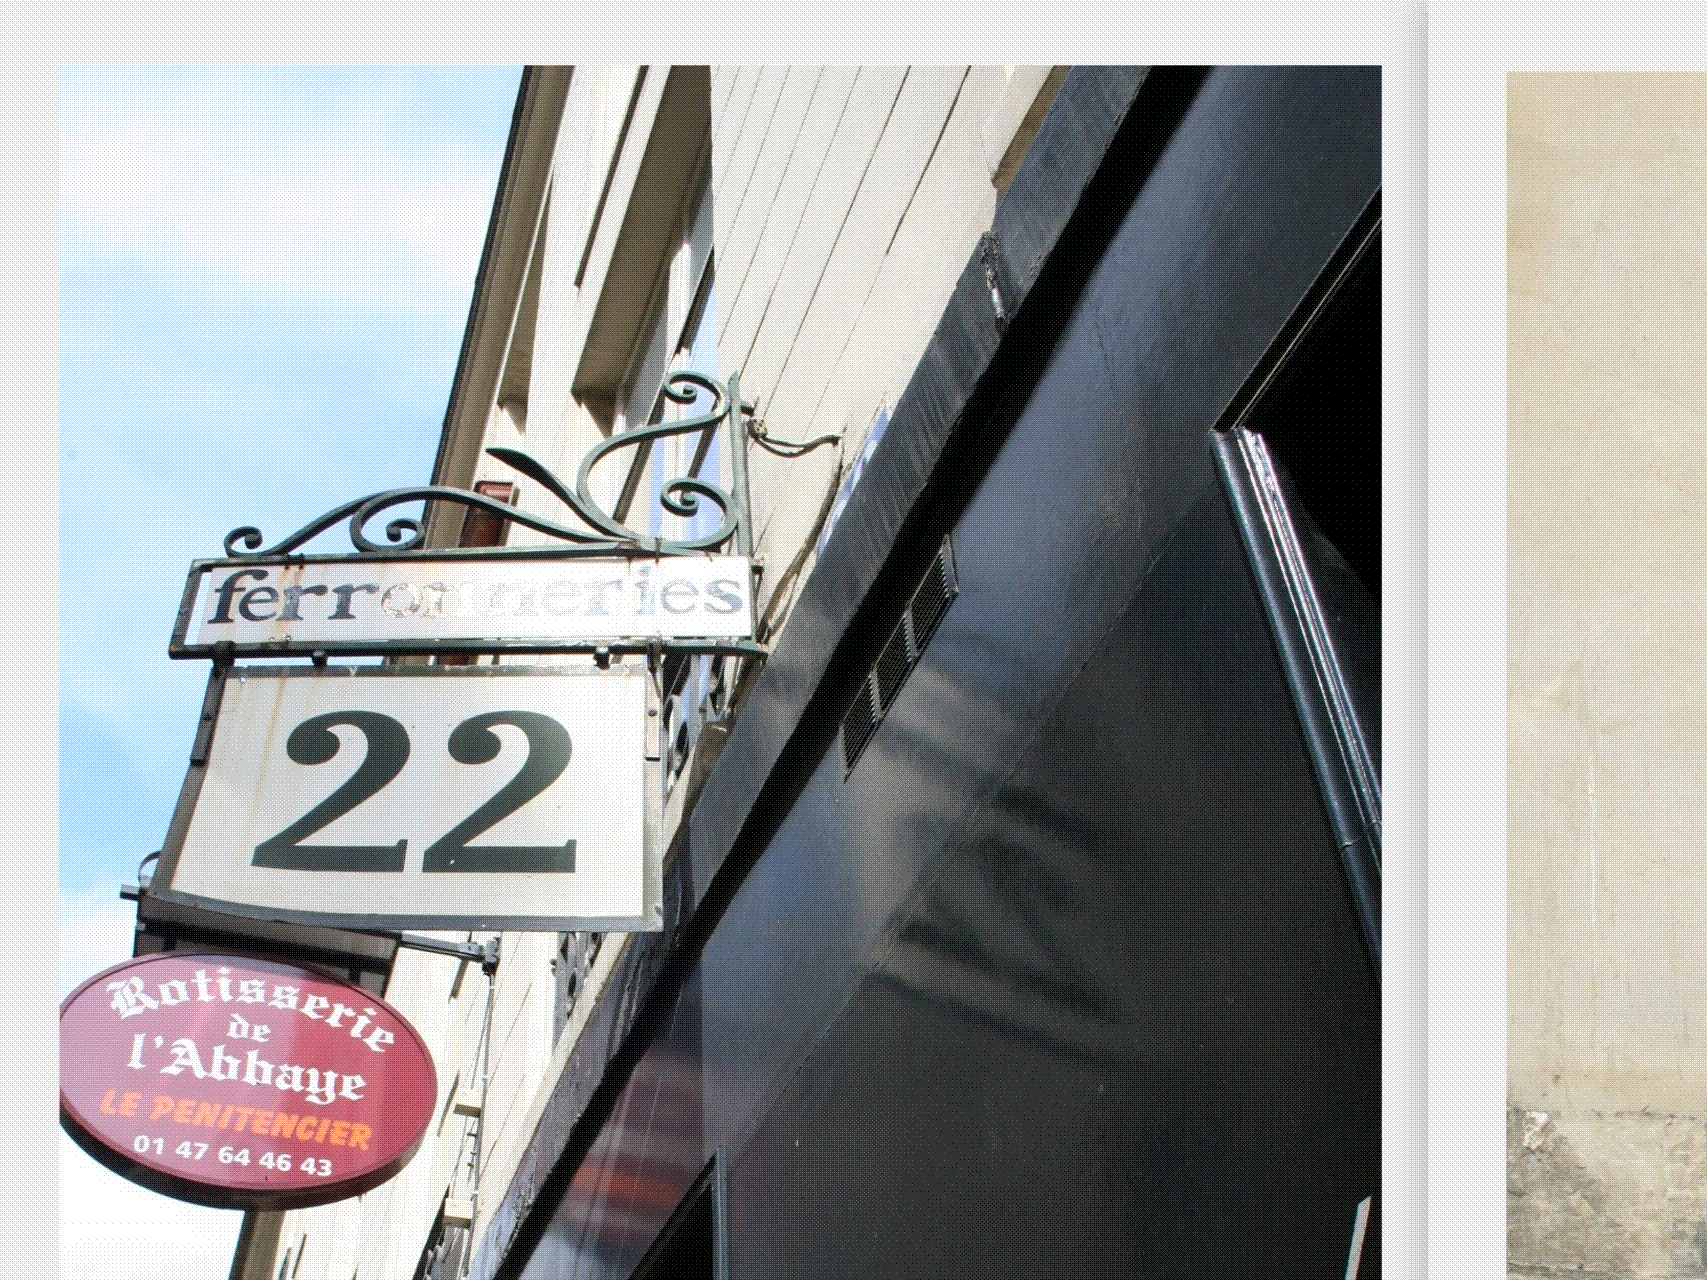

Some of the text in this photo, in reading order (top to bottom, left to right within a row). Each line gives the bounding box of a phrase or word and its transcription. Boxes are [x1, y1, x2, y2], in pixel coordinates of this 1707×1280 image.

[250, 708, 578, 874] 22
[106, 966, 396, 1053] Rotisserie
[226, 1012, 272, 1043] de
[126, 1032, 368, 1106] l'Abbaye
[99, 1087, 374, 1153] LE PENITENCIER
[132, 1134, 334, 1178] 01 47 64 46 43
